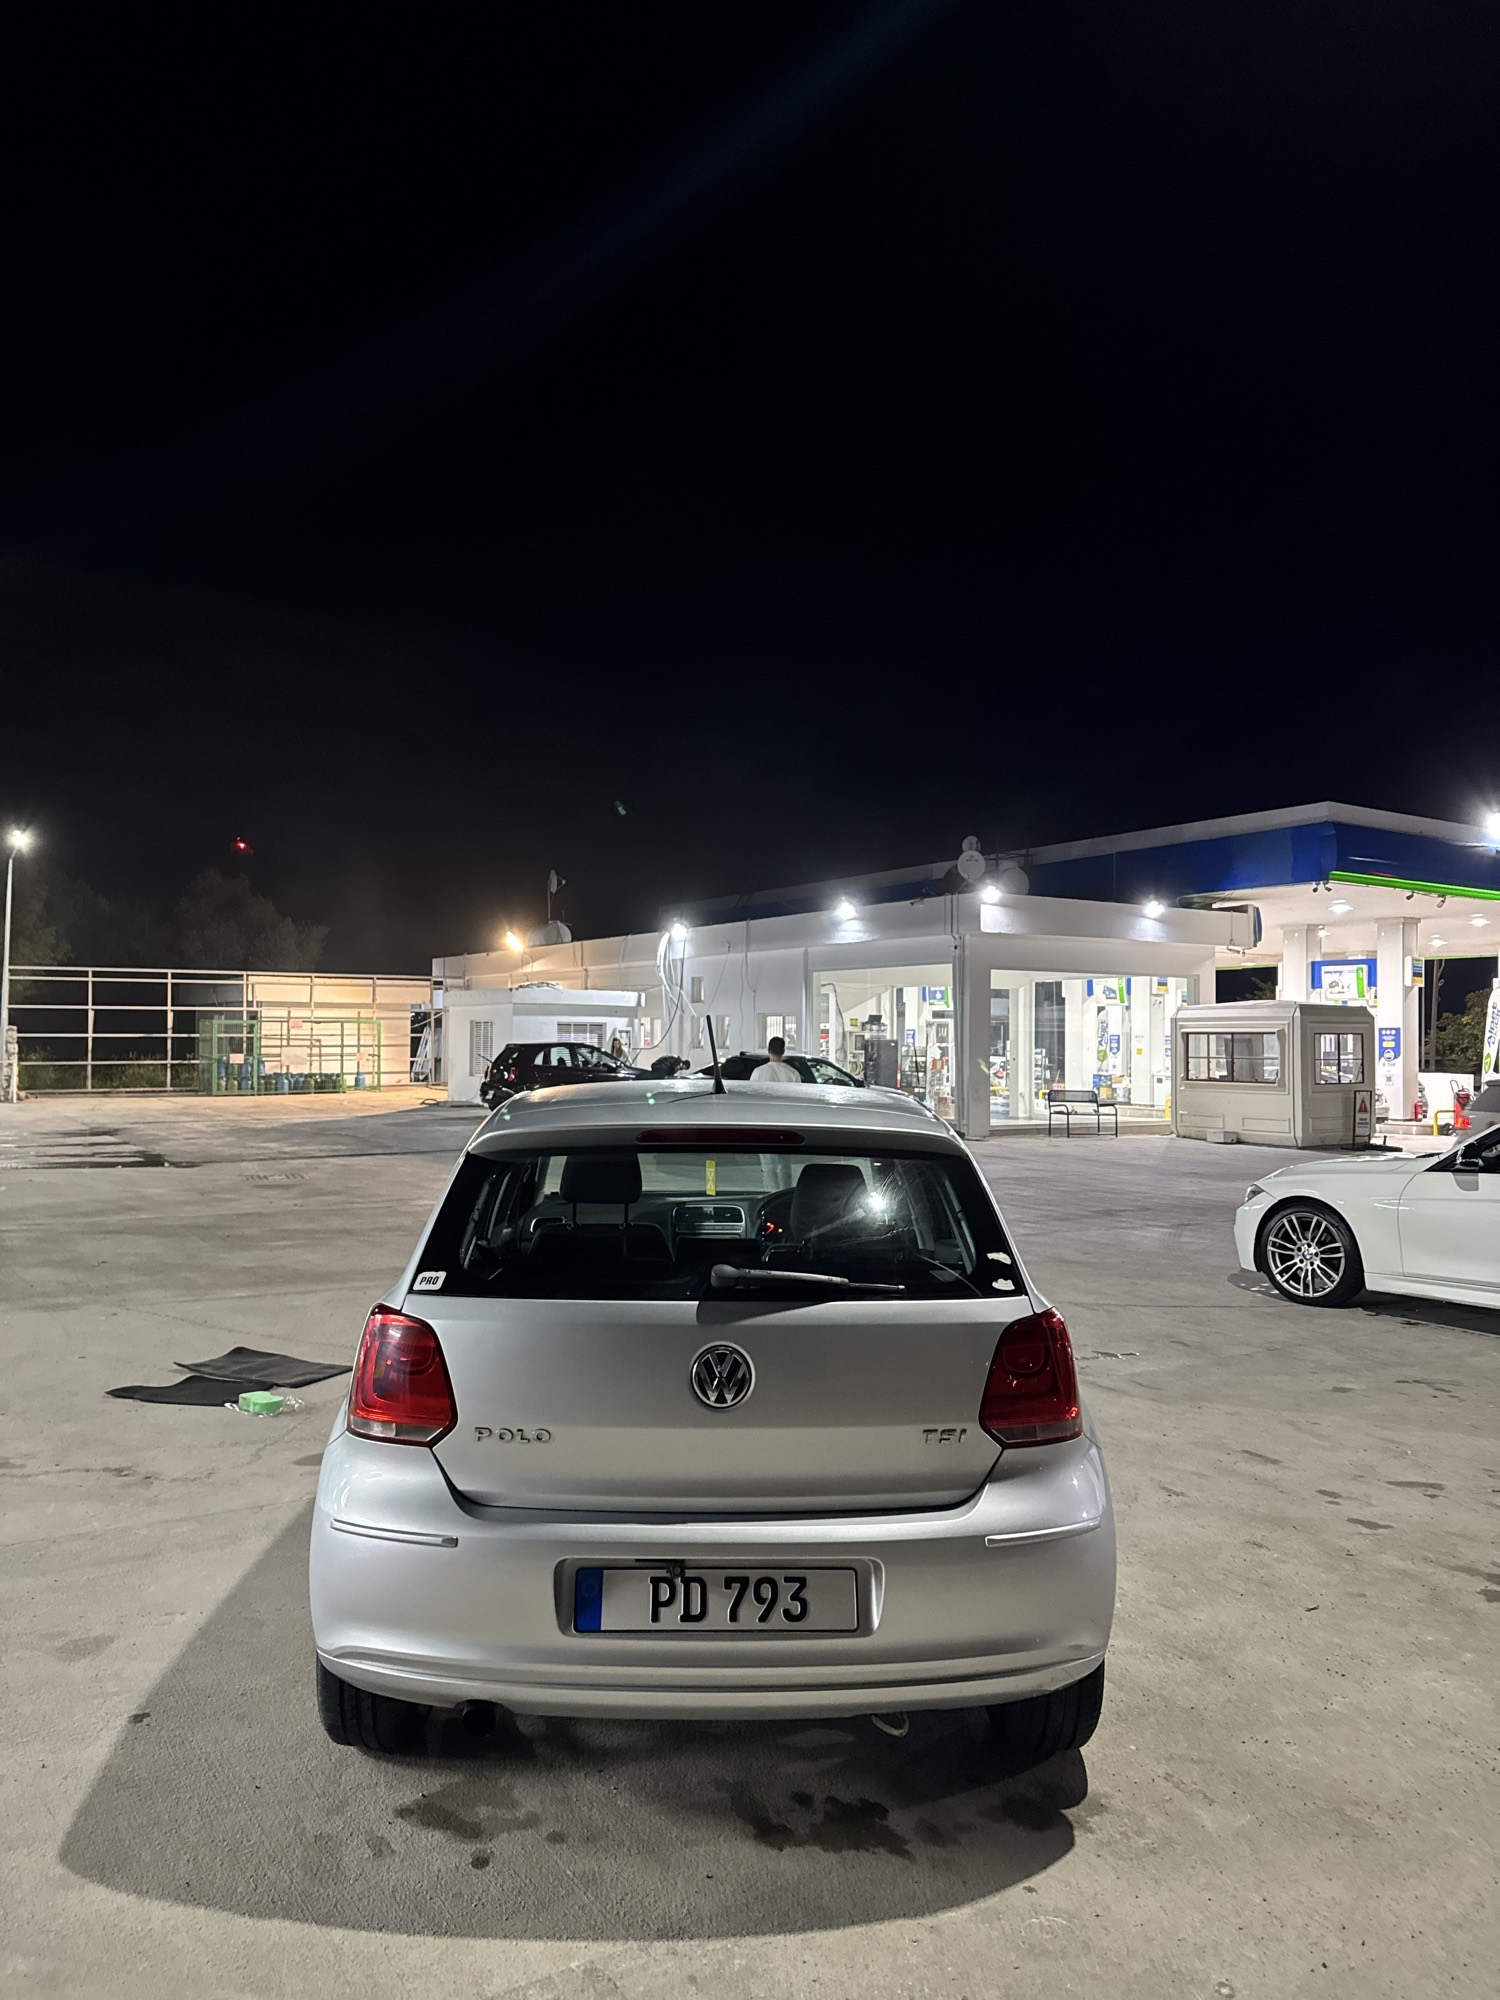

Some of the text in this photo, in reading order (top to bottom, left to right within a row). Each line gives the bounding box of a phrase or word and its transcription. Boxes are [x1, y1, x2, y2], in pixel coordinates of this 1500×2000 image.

[419, 1276, 439, 1286] PRO
[474, 1426, 551, 1443] POLO
[922, 1428, 967, 1444] TSI
[649, 1576, 808, 1623] PD 793
